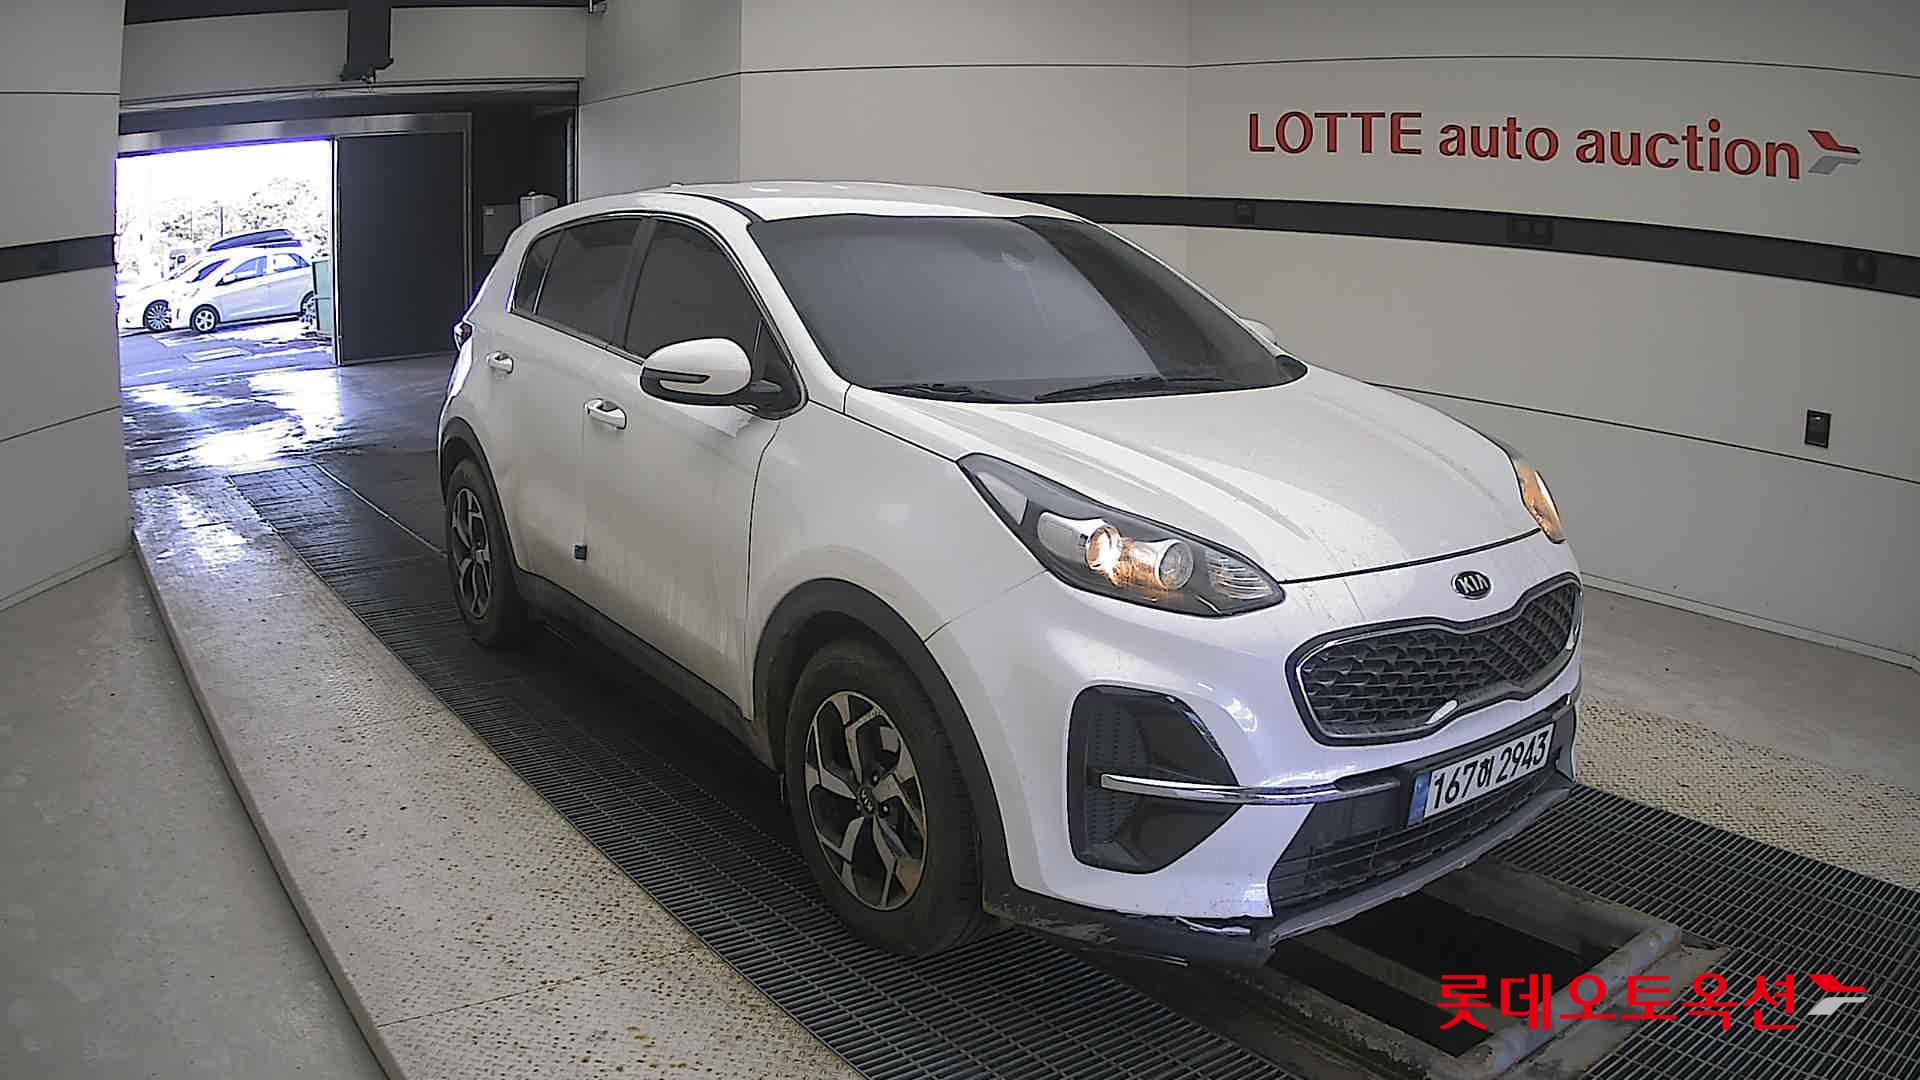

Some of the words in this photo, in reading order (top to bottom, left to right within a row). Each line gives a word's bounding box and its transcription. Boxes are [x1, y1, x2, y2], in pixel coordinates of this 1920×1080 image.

[1248, 112, 1422, 155] LOTTE
[1439, 117, 1560, 162] auto
[1575, 118, 1800, 180] auction
[1457, 574, 1489, 594] KIA
[1496, 730, 1550, 784] 2943
